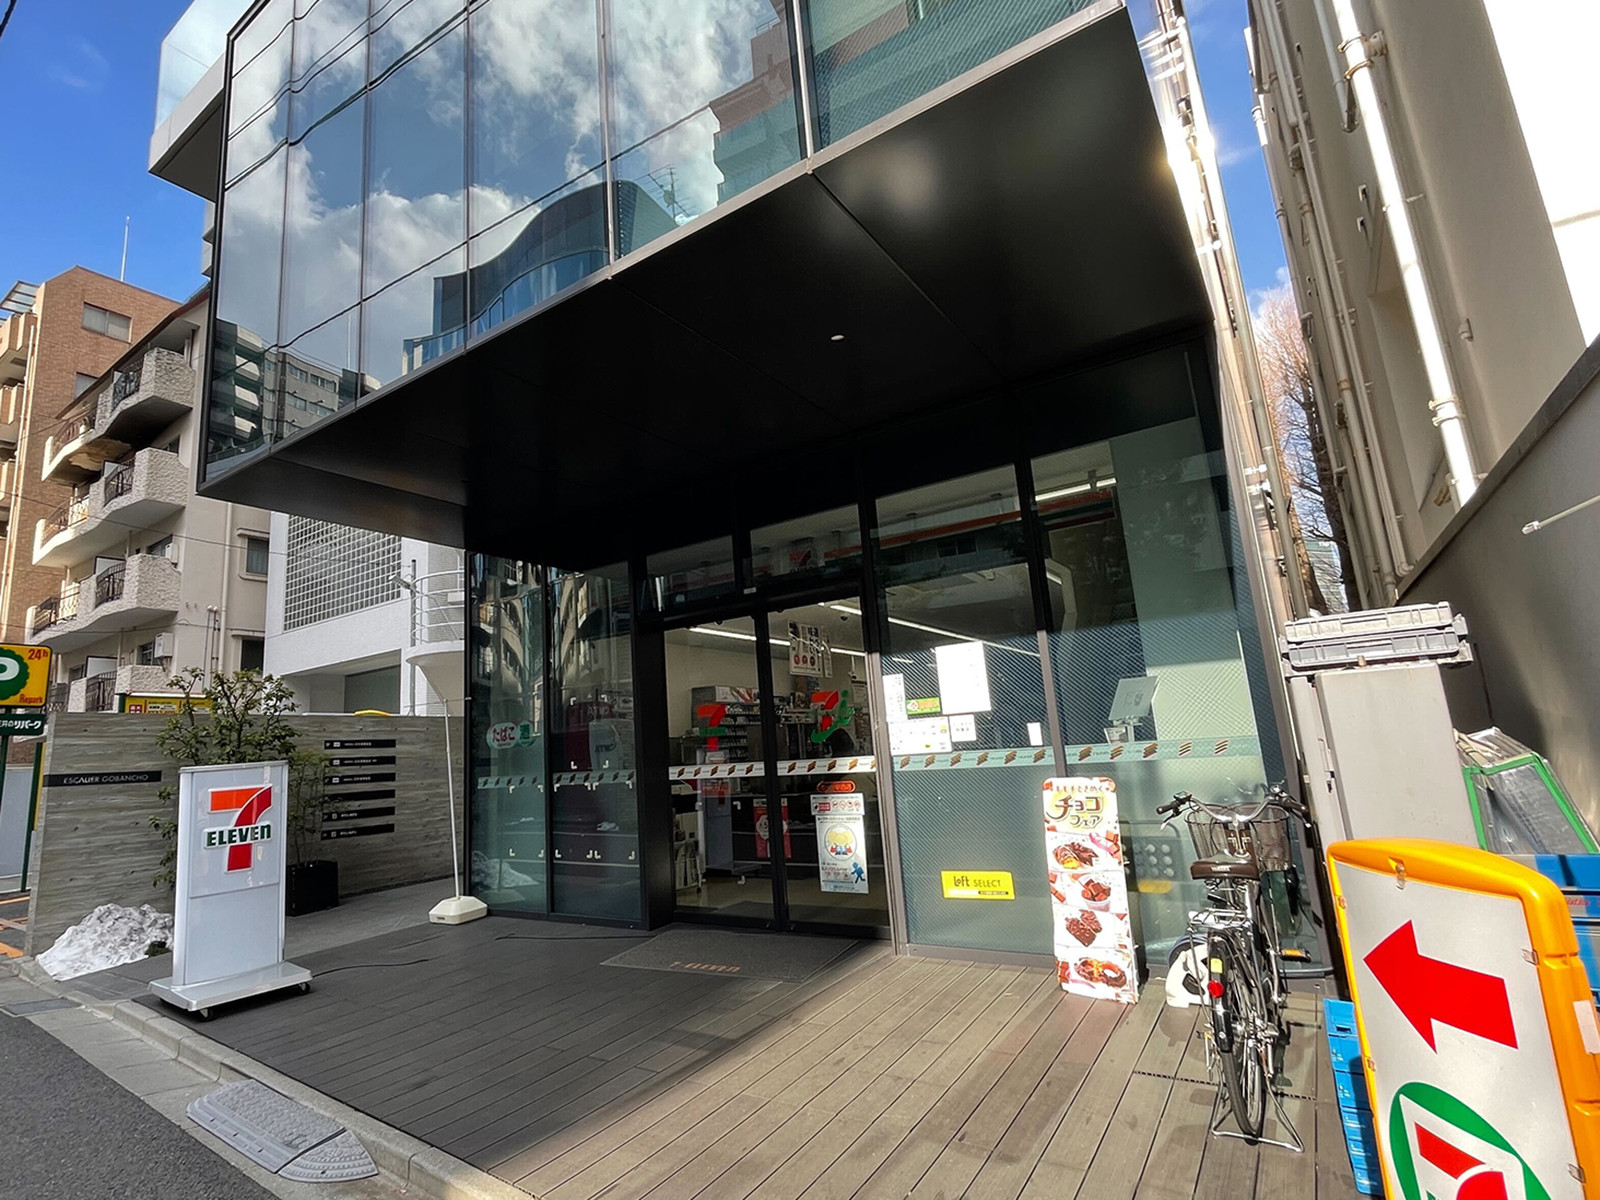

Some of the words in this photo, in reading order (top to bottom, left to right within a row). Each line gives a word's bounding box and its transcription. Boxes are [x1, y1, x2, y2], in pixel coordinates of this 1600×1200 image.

[492, 726, 516, 743] たばこ
[63, 776, 100, 785] ESCALIER
[101, 774, 149, 783] GOBANCHO
[1046, 795, 1101, 820] チョコ
[1069, 815, 1101, 826] フェア
[973, 879, 1001, 888] SELECT
